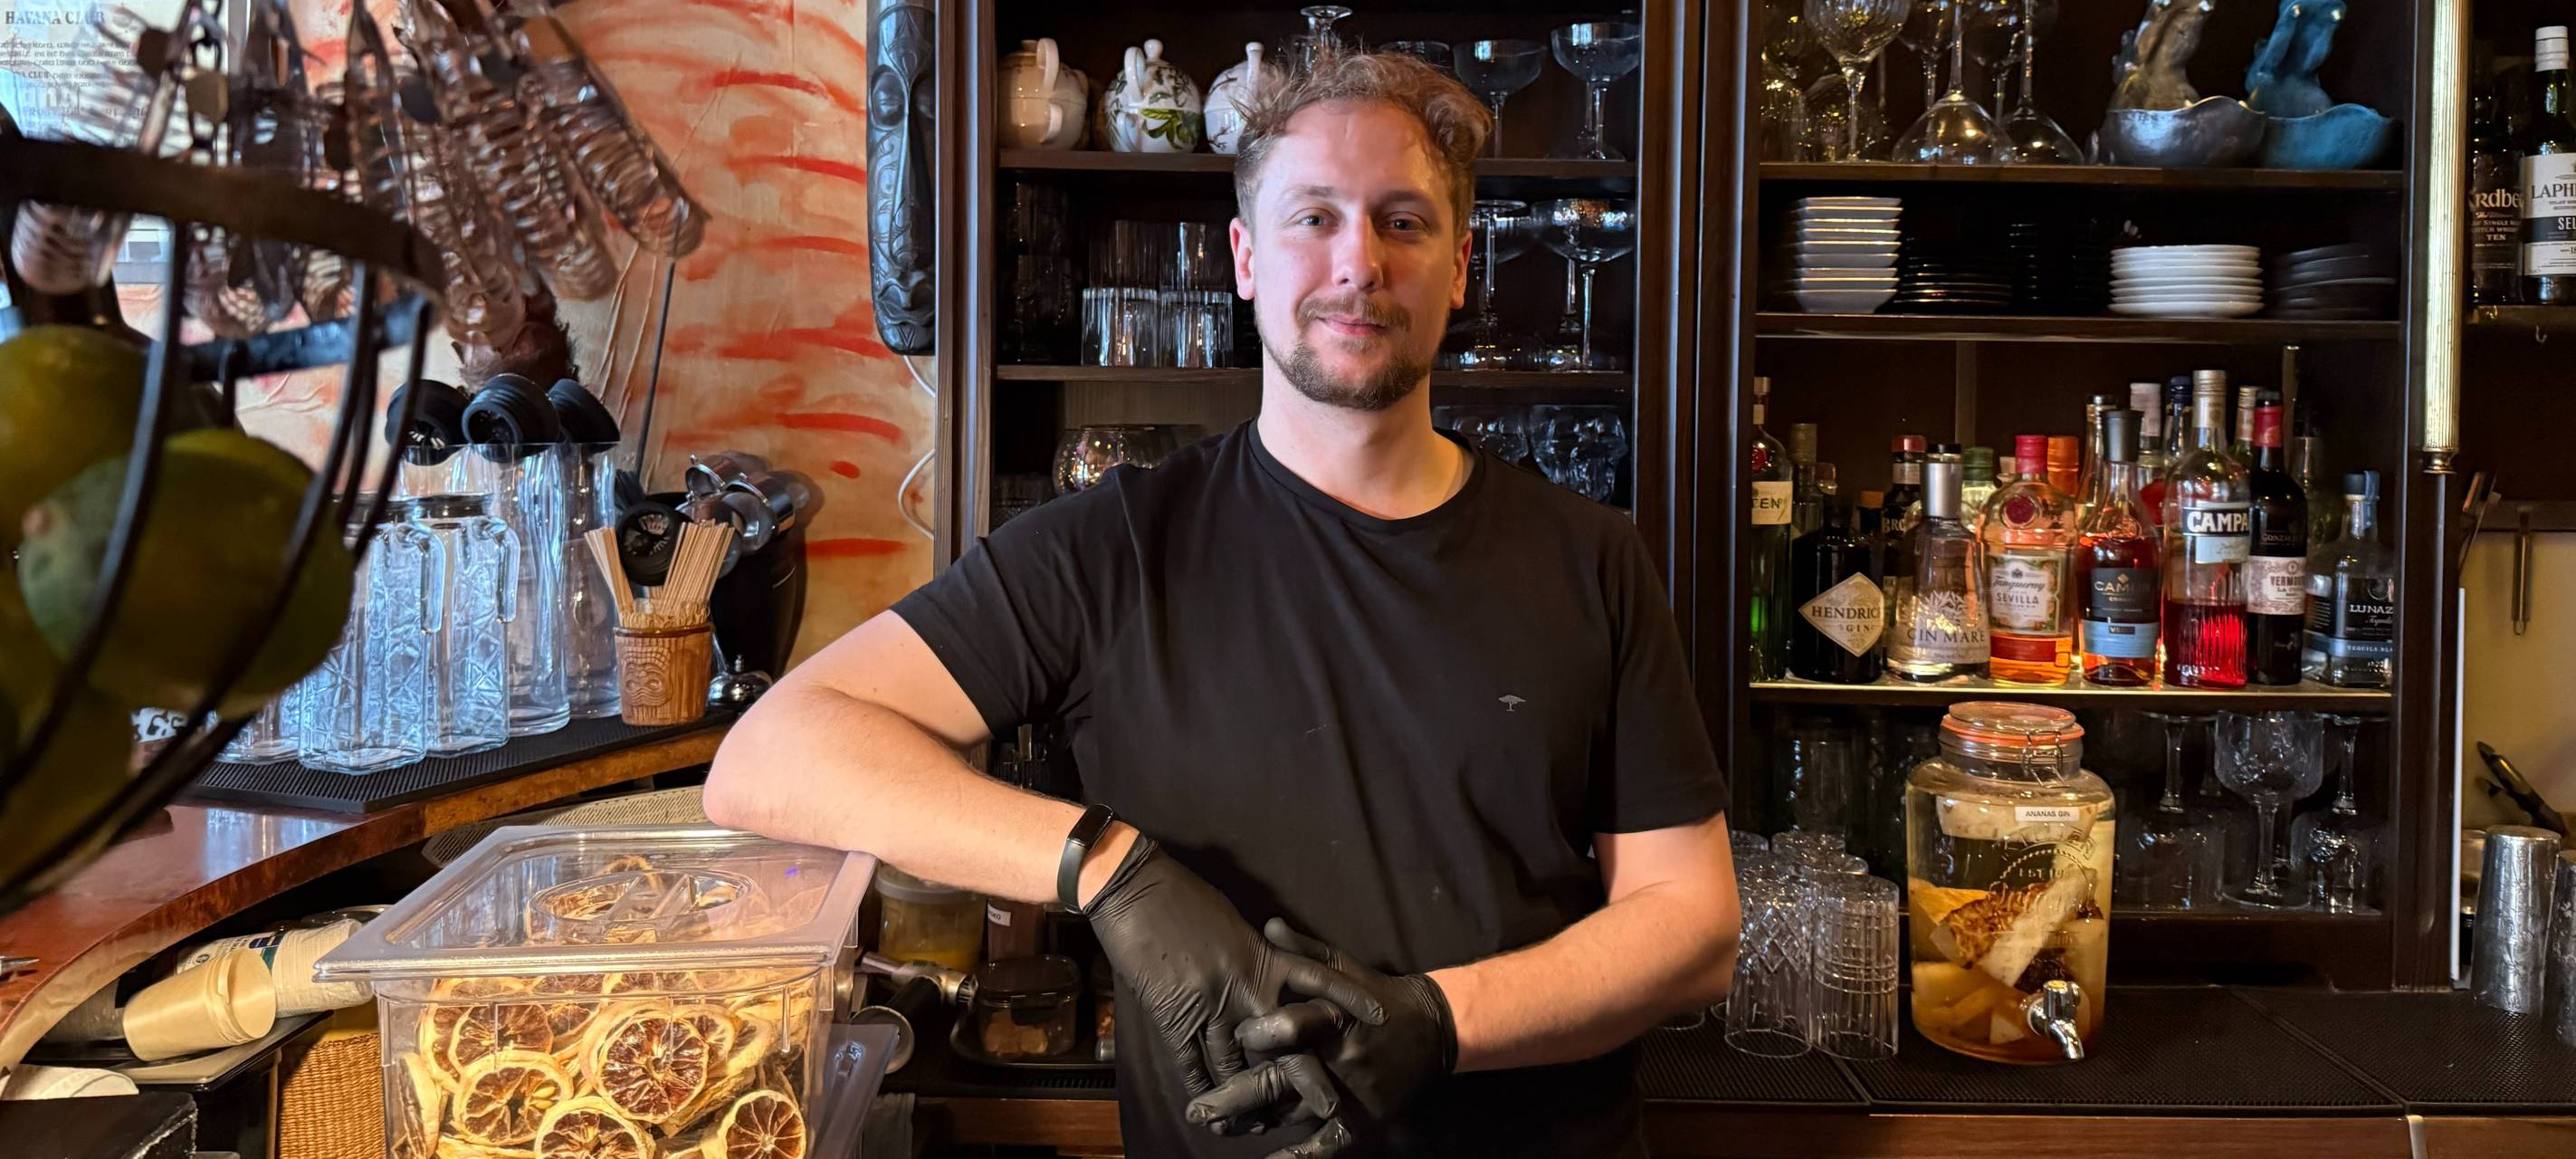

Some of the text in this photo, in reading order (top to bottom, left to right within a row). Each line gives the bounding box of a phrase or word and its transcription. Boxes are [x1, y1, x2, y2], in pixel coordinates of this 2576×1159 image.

[5, 11, 62, 24] HAVANA
[2531, 183, 2576, 199] LAPH
[2558, 217, 2576, 230] SEL
[1883, 517, 1905, 533] BRO
[2187, 511, 2249, 532] CAMPA
[1997, 592, 2039, 604] SEVILLA
[1811, 605, 1880, 619] HENDRIC
[2350, 604, 2394, 615] LUNAZ
[1846, 624, 1870, 633] GIN
[1906, 628, 1986, 644] GIN MARE
